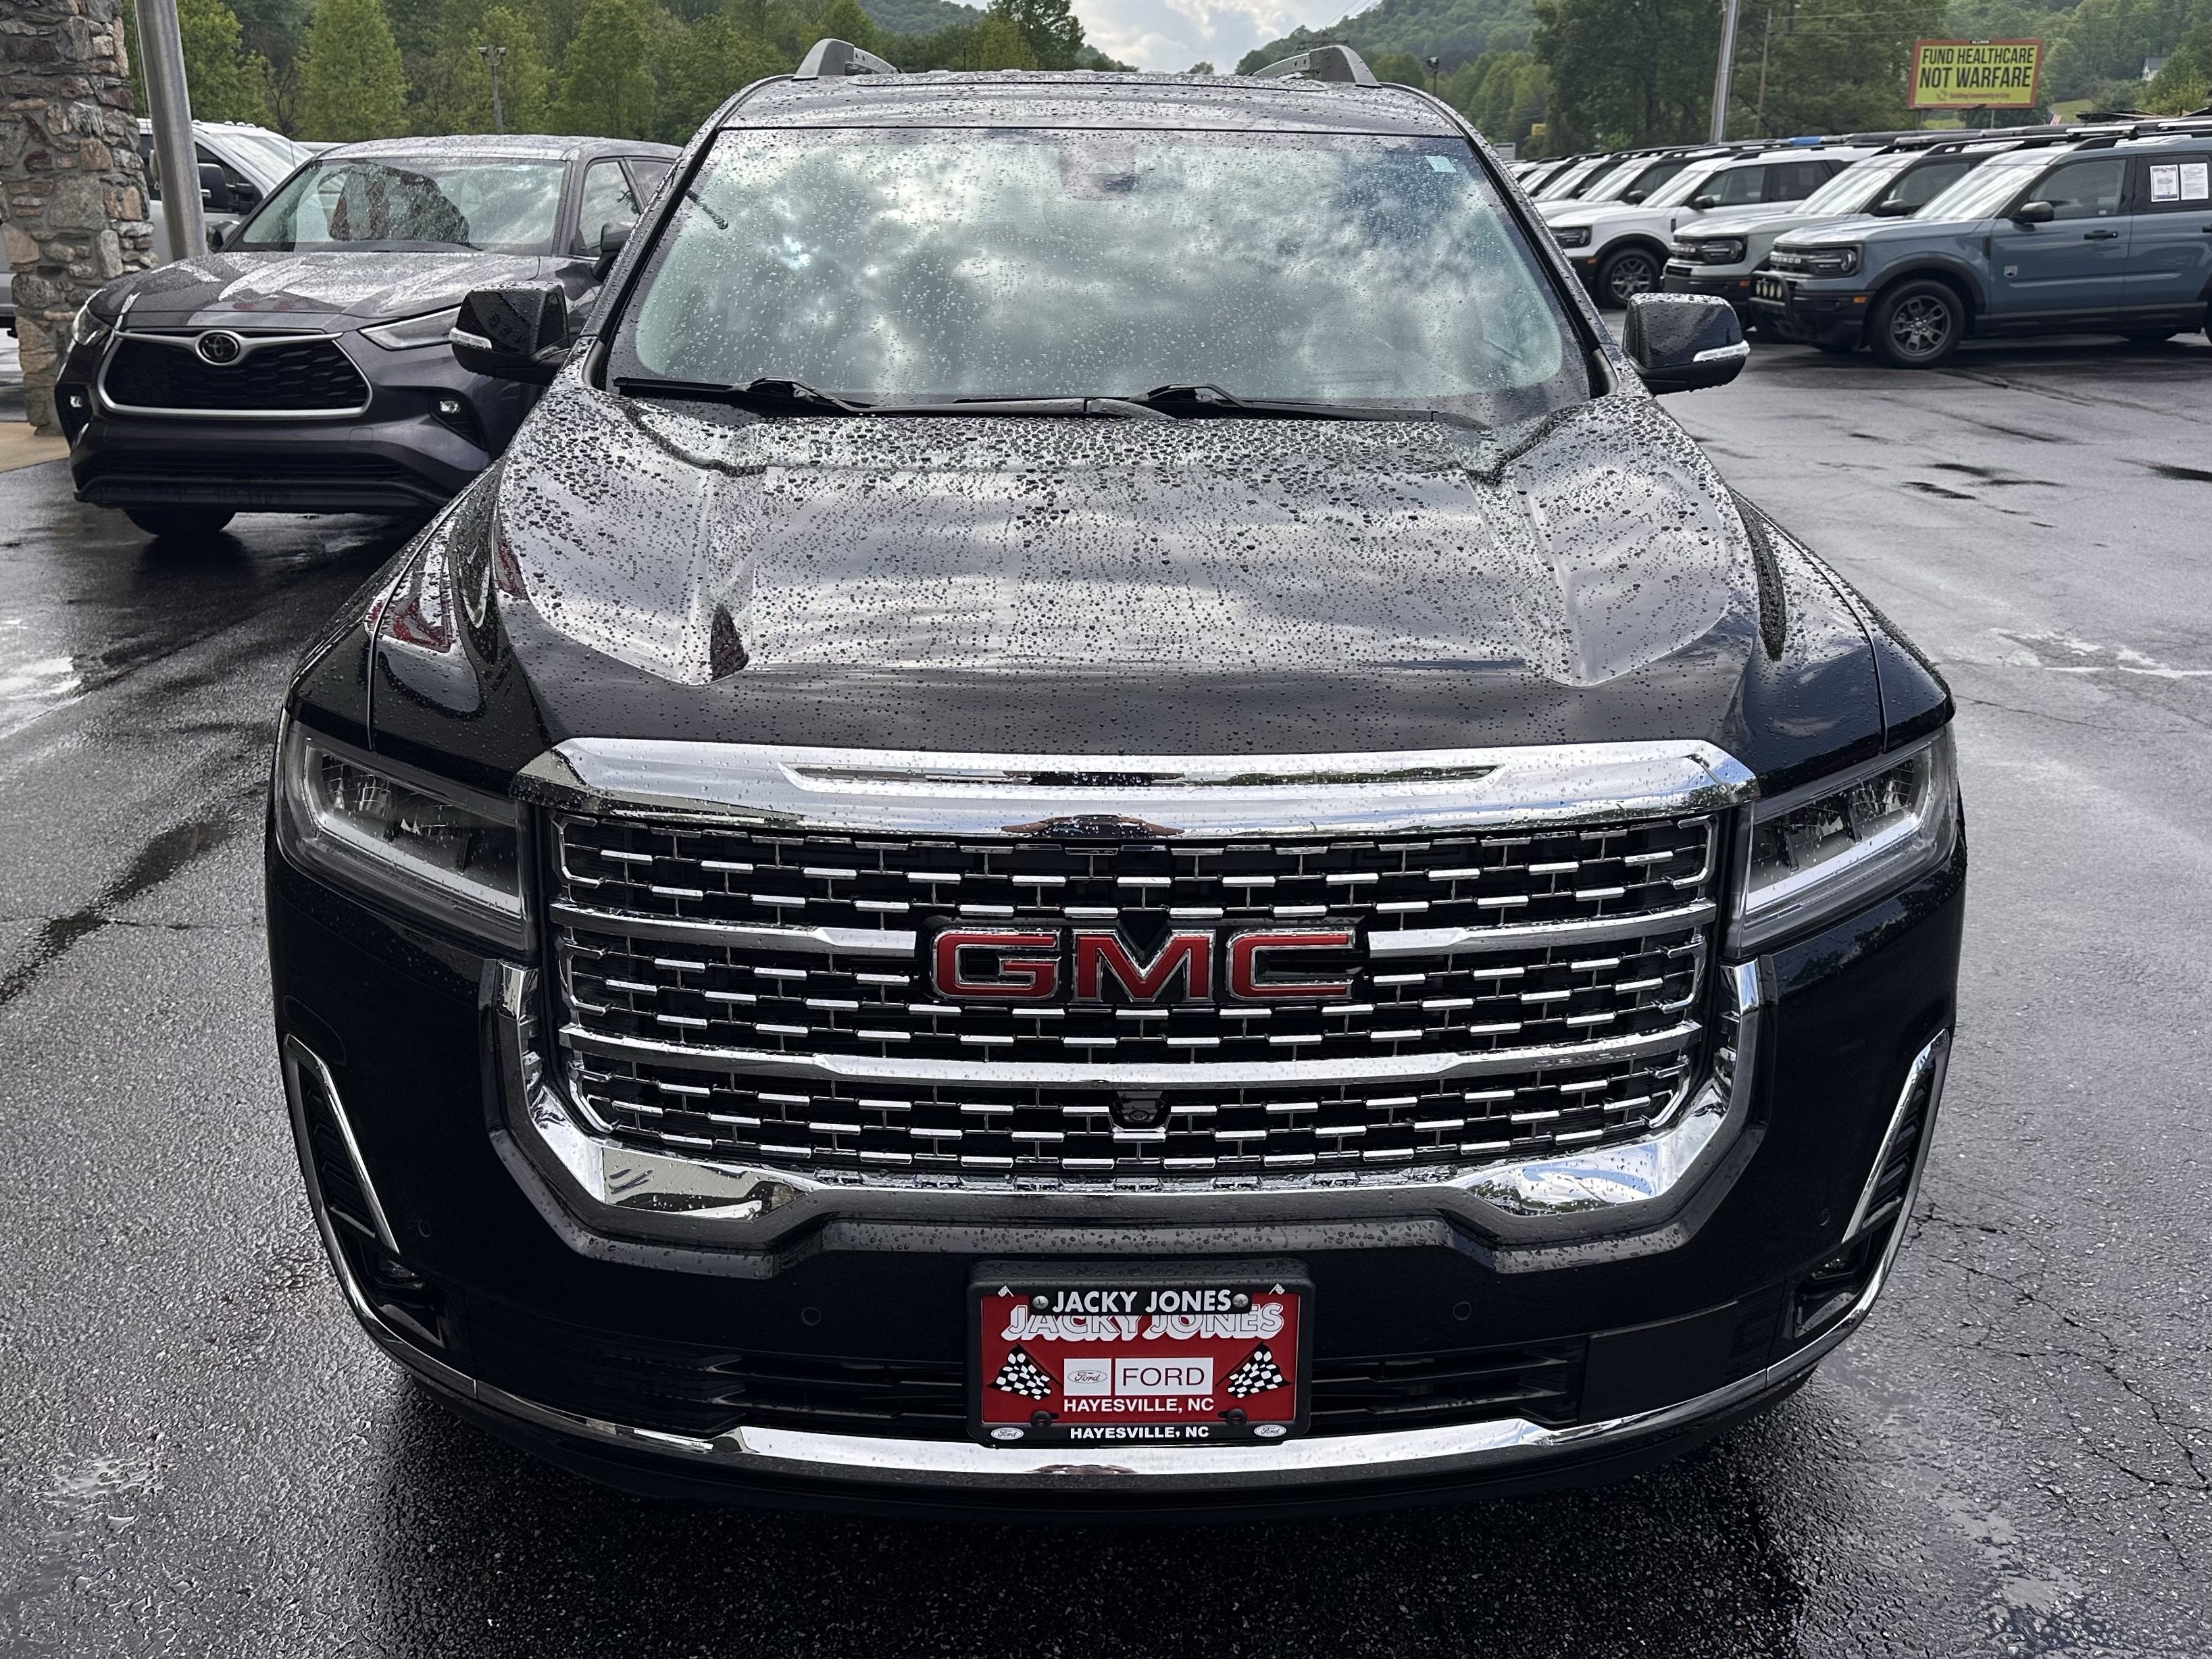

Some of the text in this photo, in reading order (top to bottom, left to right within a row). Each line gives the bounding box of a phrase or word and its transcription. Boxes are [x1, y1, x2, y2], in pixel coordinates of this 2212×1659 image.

[1922, 47, 2035, 64] FUND HEALTHCARE
[1919, 66, 2032, 88] NOT WARFARE
[930, 927, 1356, 1002] GMC
[1052, 1290, 1231, 1312] JACKY JONES
[1001, 1305, 1142, 1341] JACKY
[1074, 1372, 1101, 1381] Ford
[1123, 1367, 1205, 1386] FORD
[1063, 1398, 1215, 1413] HAYESVILLE, NC
[1070, 1426, 1209, 1438] HAYESVILLE, NC
